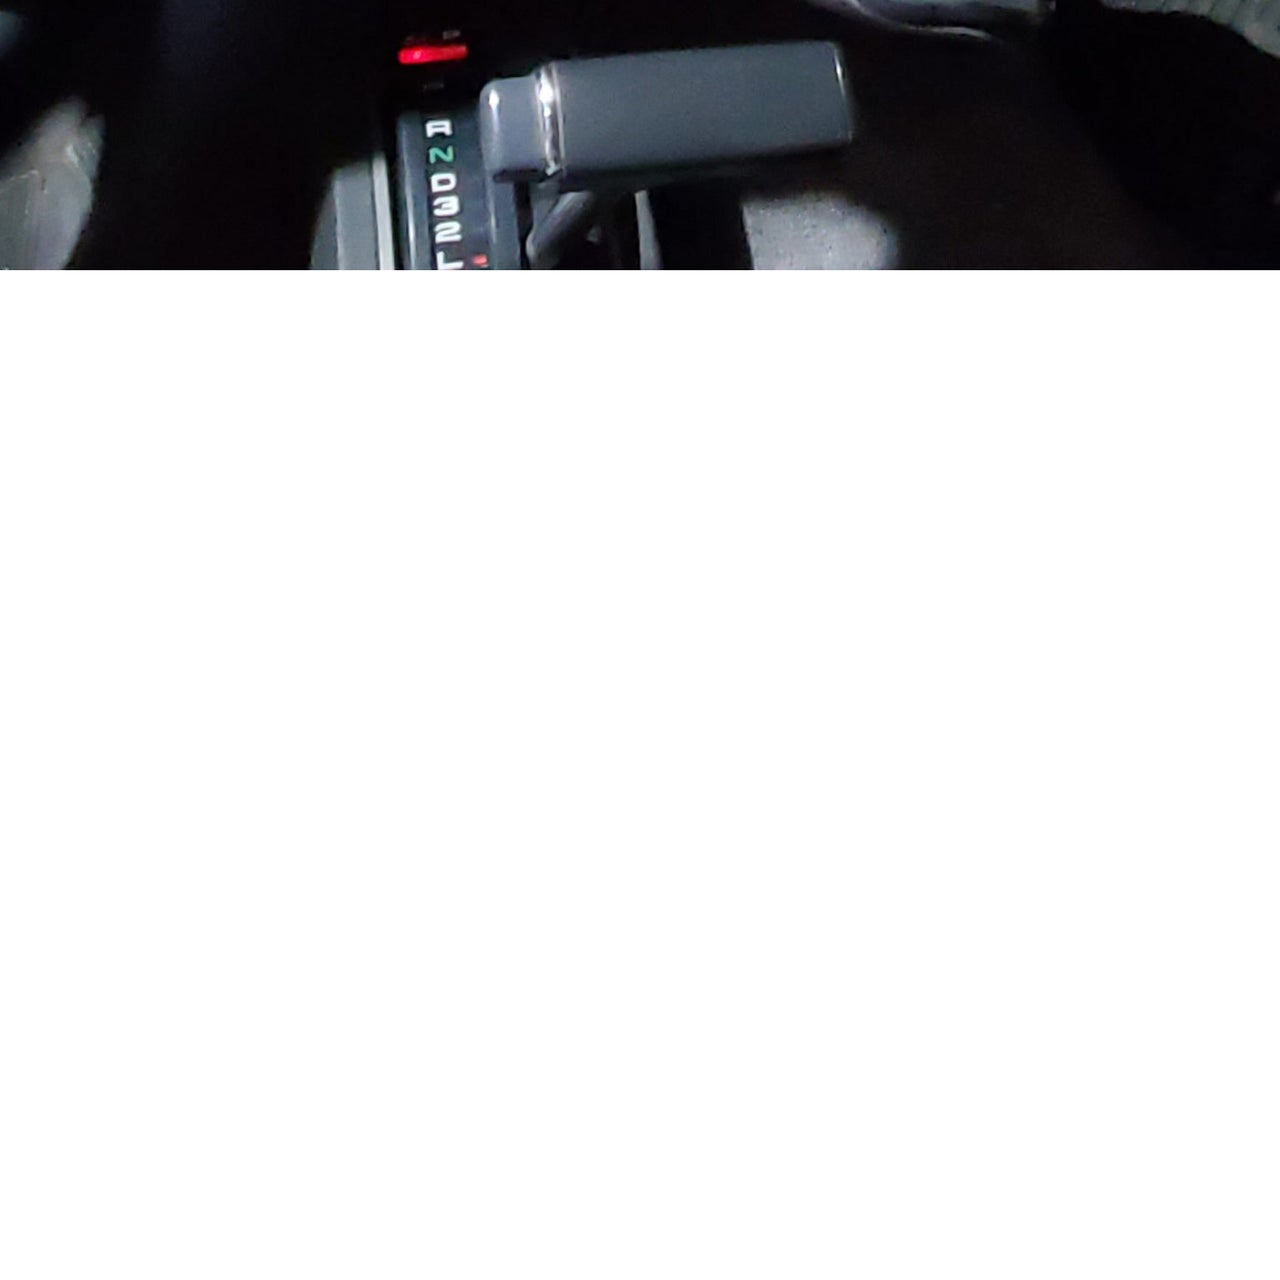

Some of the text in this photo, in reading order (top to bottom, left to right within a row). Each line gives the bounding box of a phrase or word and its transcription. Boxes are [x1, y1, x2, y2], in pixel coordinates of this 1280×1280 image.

[429, 146, 454, 164] N
[431, 173, 457, 193] D
[433, 195, 459, 217] 3
[435, 221, 462, 244] 2
[437, 251, 464, 270] L
